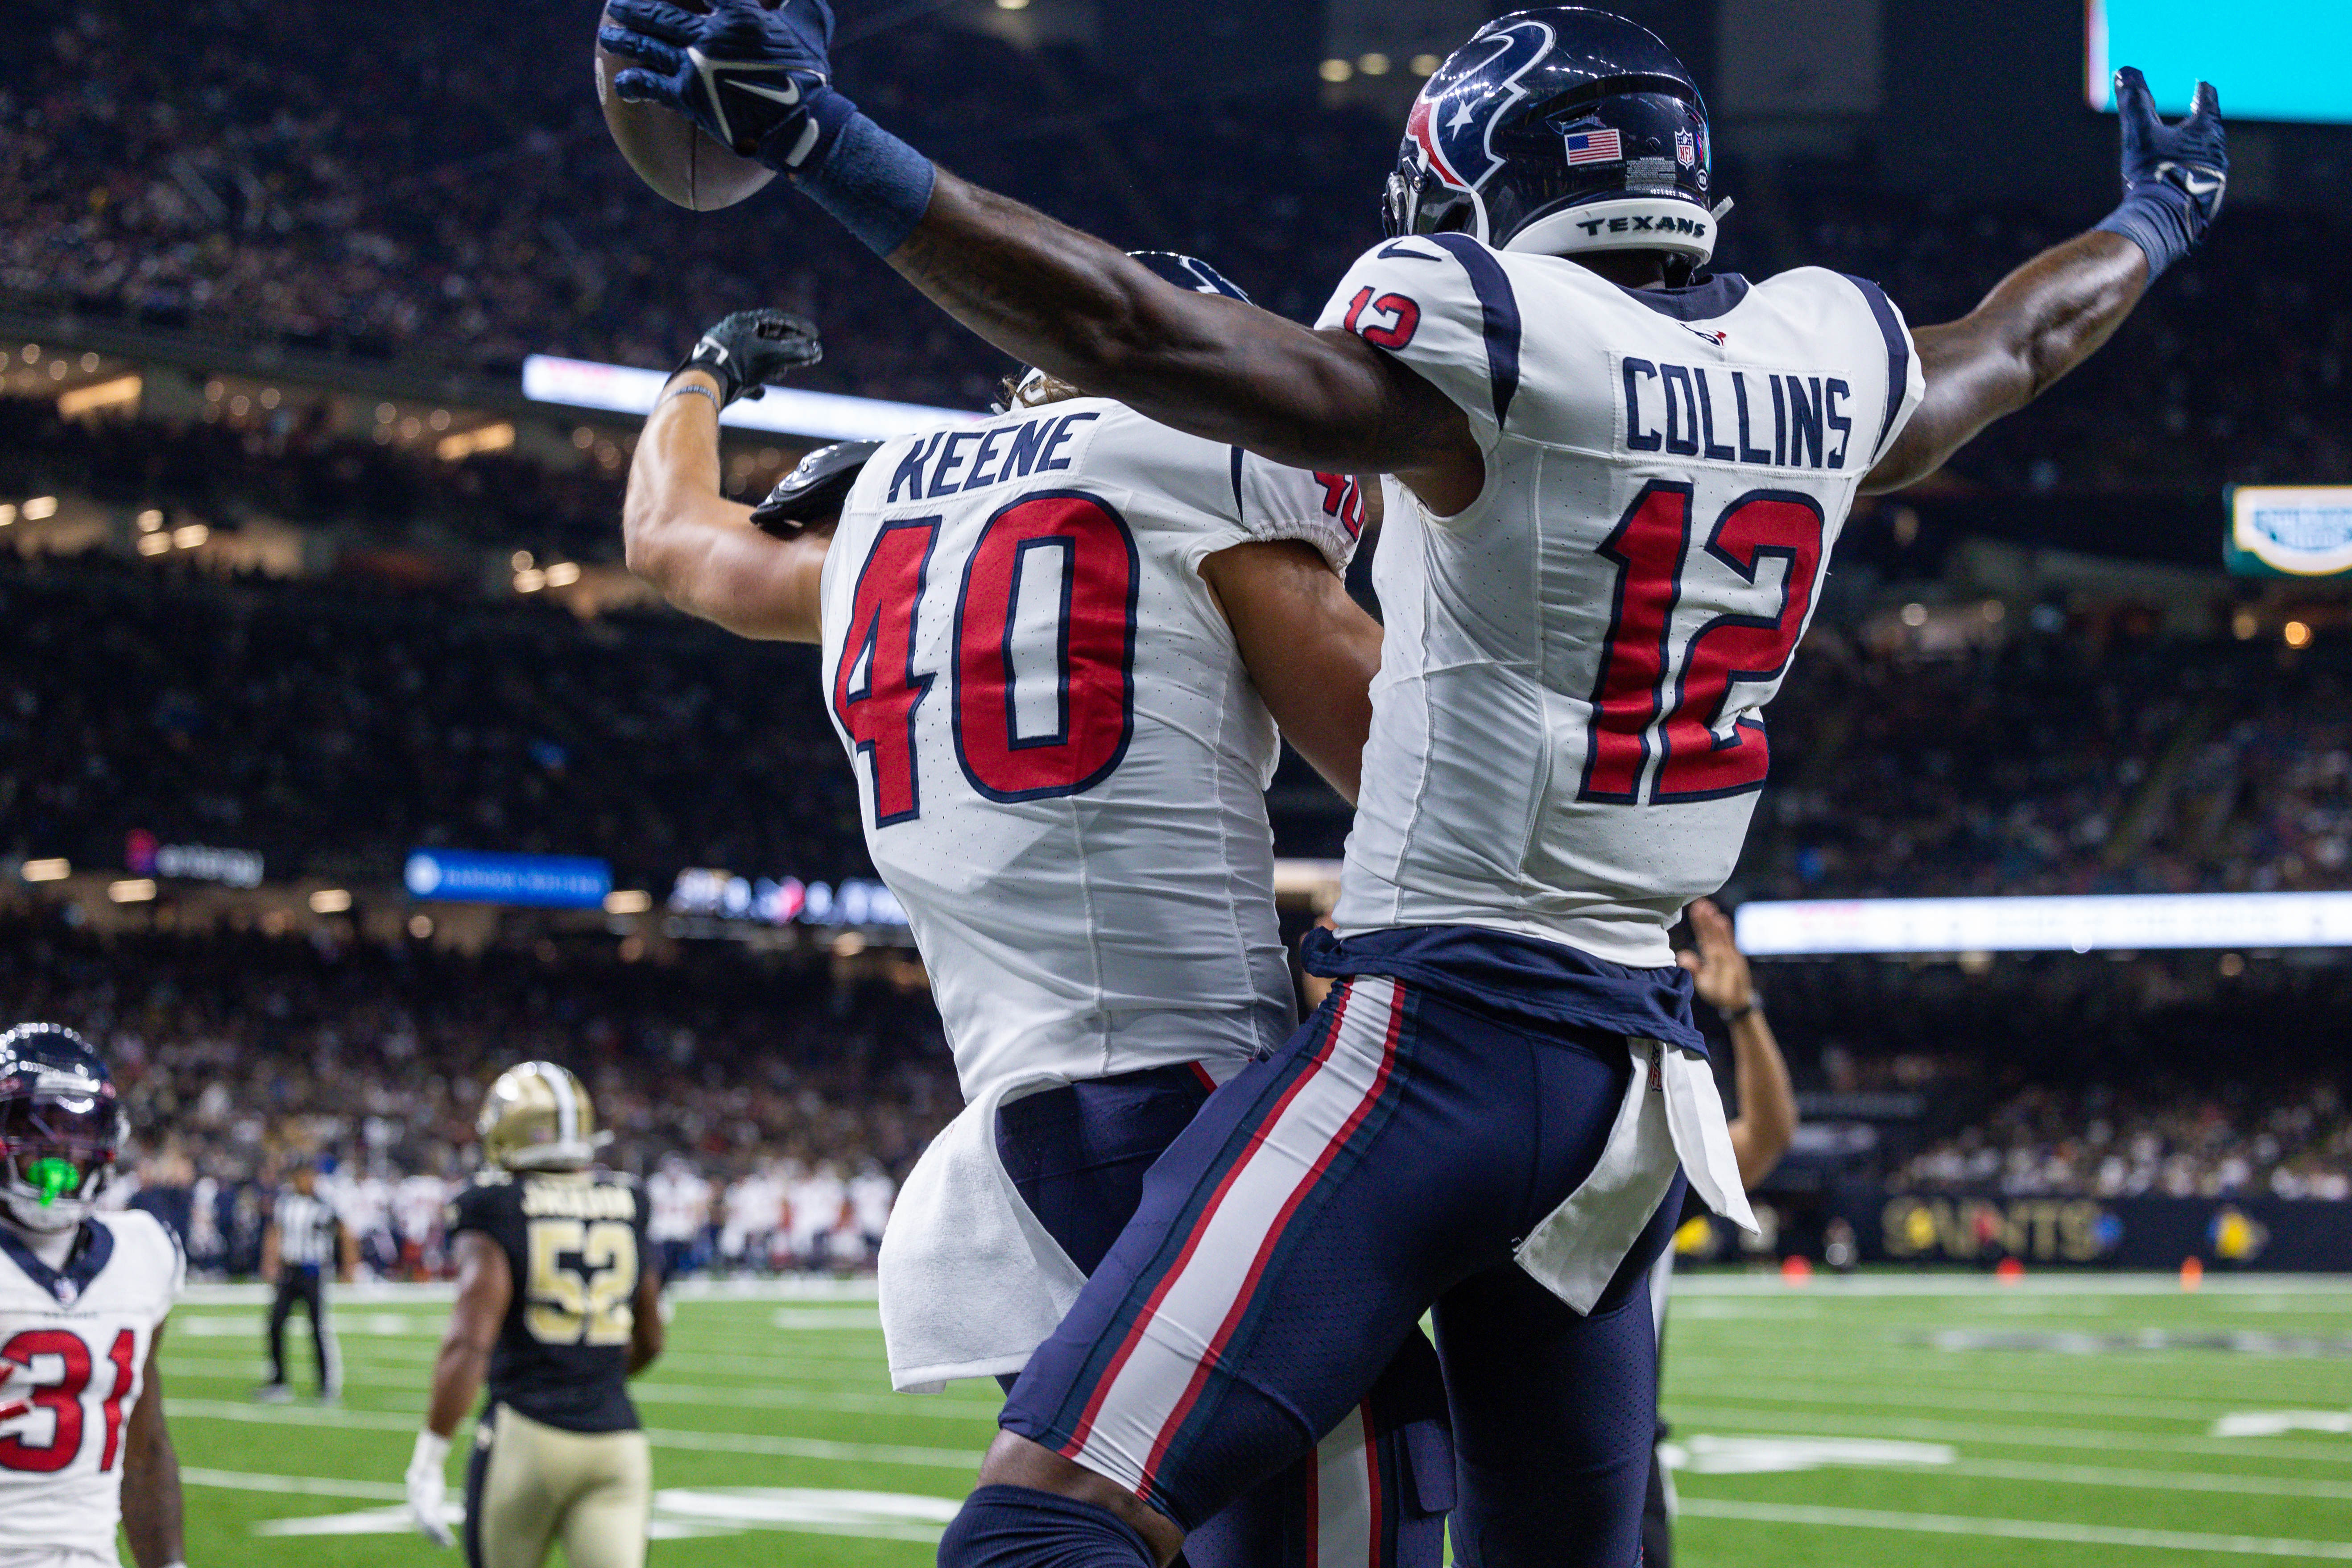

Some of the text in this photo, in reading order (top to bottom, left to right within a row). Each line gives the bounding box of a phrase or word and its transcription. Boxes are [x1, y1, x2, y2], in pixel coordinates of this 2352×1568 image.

[1680, 146, 1693, 162] NFL
[1576, 216, 1706, 238] TEXANS
[1343, 285, 1421, 351] 12
[886, 412, 1100, 503] KEENE
[1622, 357, 1852, 469] COLLINS
[833, 488, 1140, 830] 40
[1576, 479, 1825, 805] 12
[524, 1220, 639, 1346] 52
[0, 1328, 135, 1473] 31
